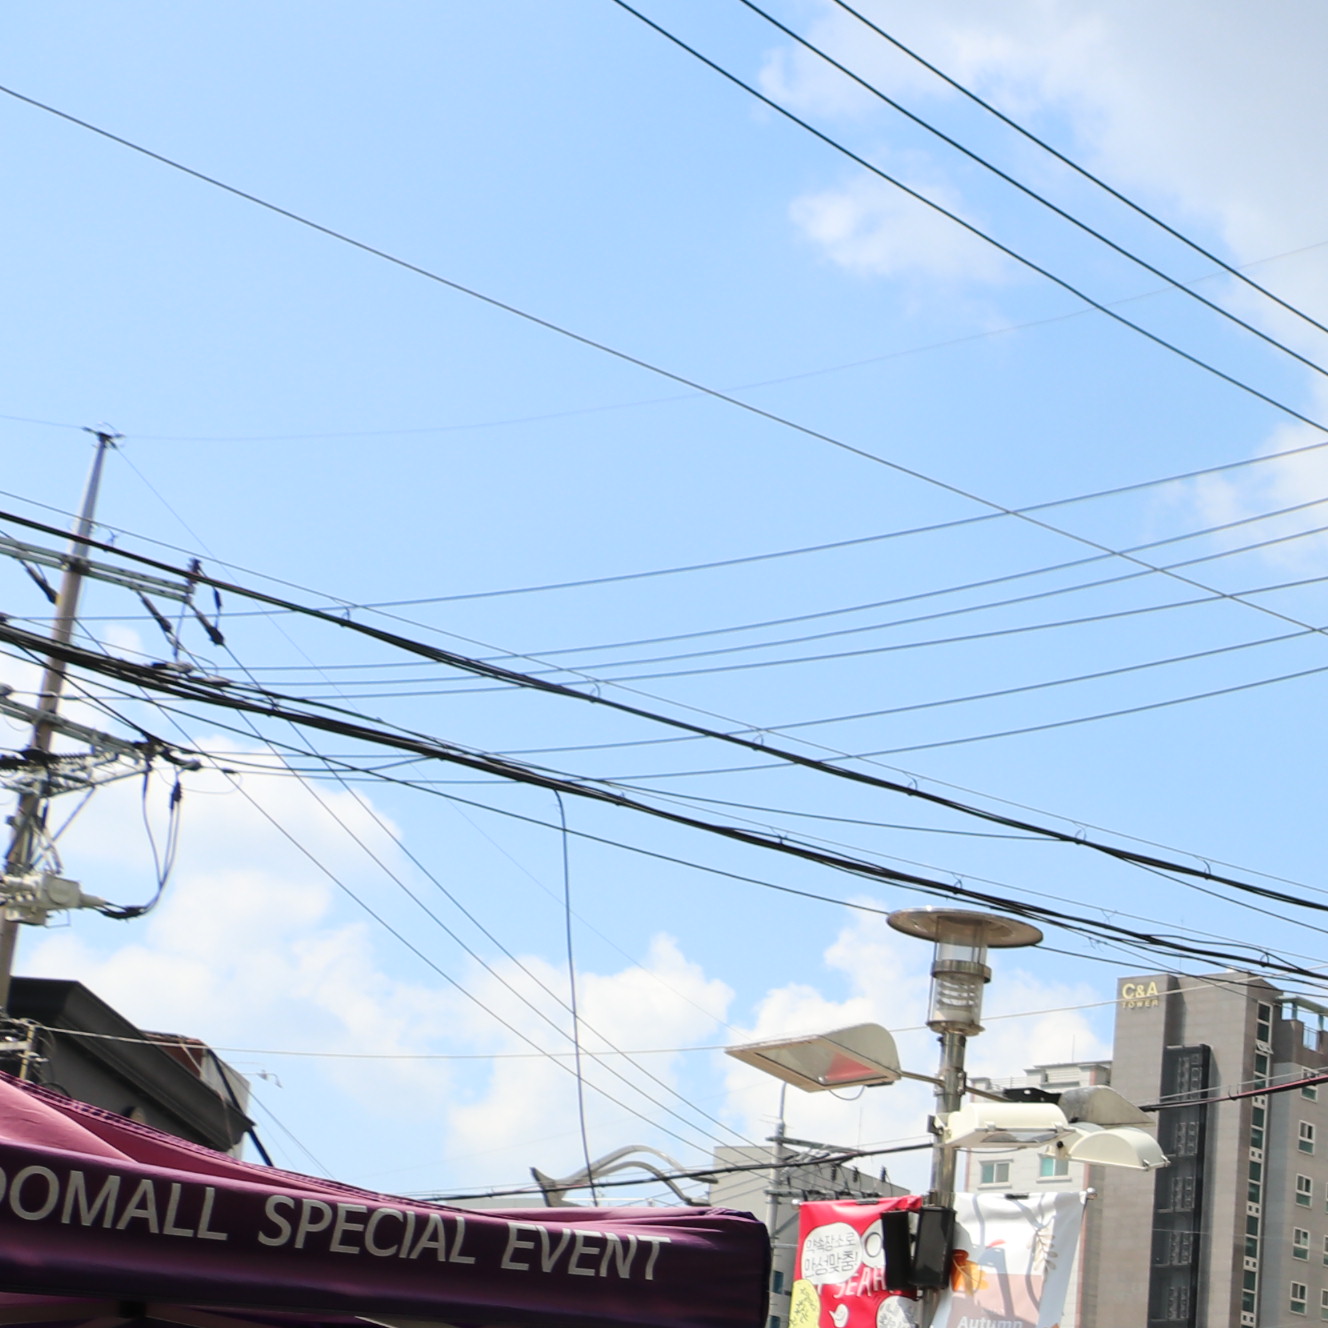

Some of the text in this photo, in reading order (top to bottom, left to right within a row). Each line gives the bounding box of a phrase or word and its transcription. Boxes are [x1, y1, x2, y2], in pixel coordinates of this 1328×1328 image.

[0, 1164, 672, 1281] OMALL SPECIAL EVENT
